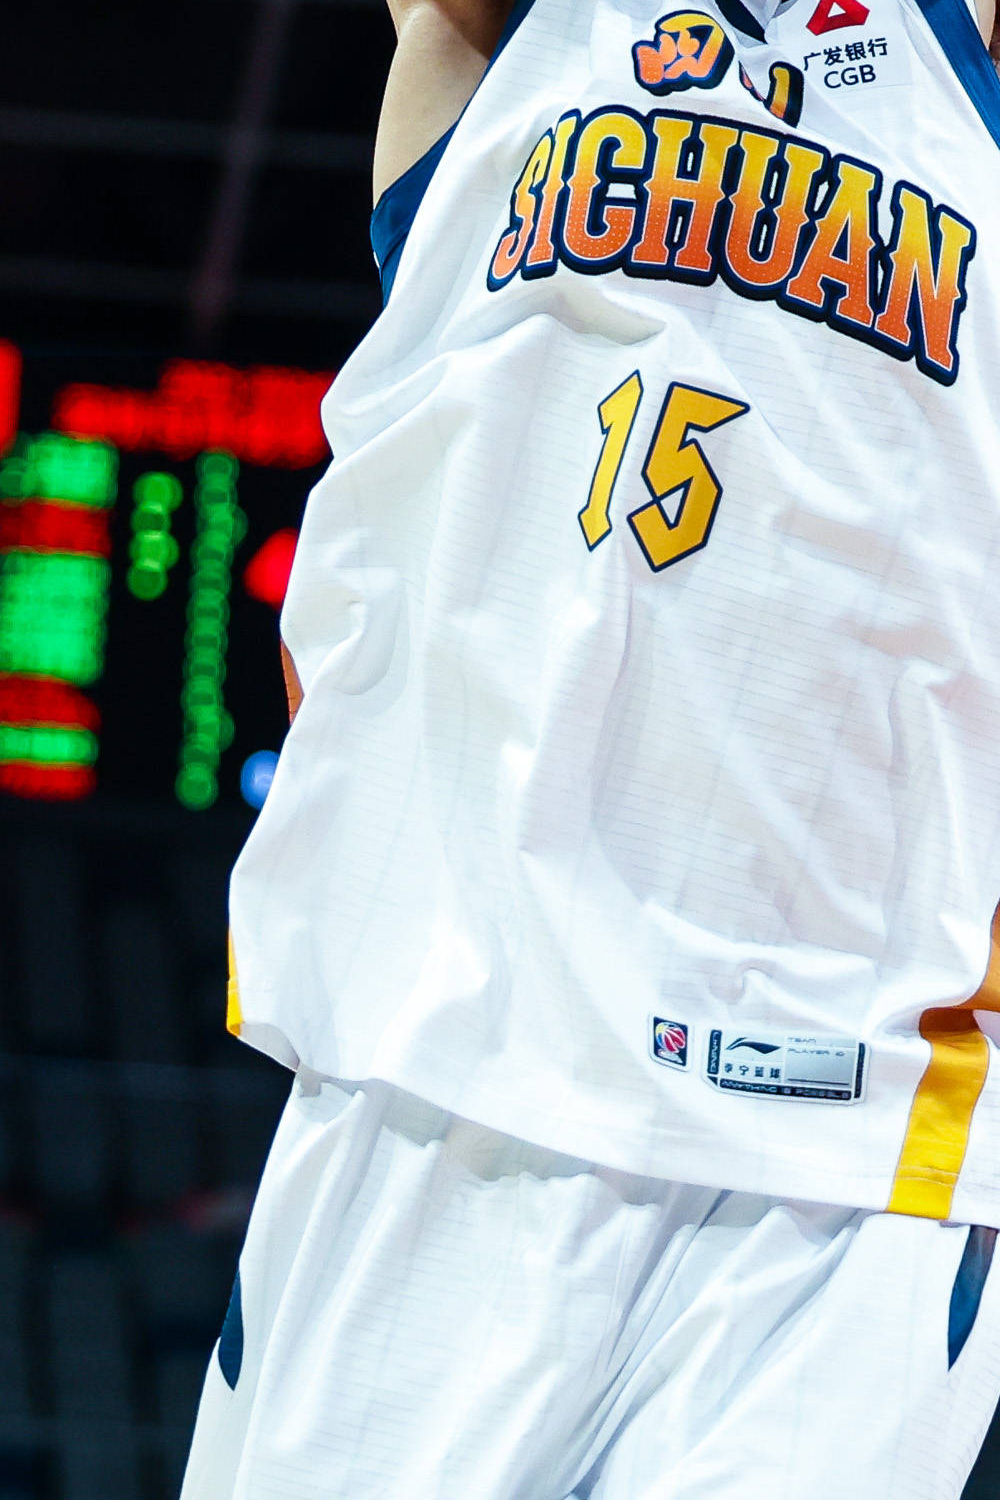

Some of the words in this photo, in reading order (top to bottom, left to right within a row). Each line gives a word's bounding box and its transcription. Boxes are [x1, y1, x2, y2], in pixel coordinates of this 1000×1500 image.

[803, 37, 888, 72] 广发银行
[823, 64, 876, 89] CGB
[487, 104, 977, 387] SICHUAN
[577, 369, 750, 573] 15
